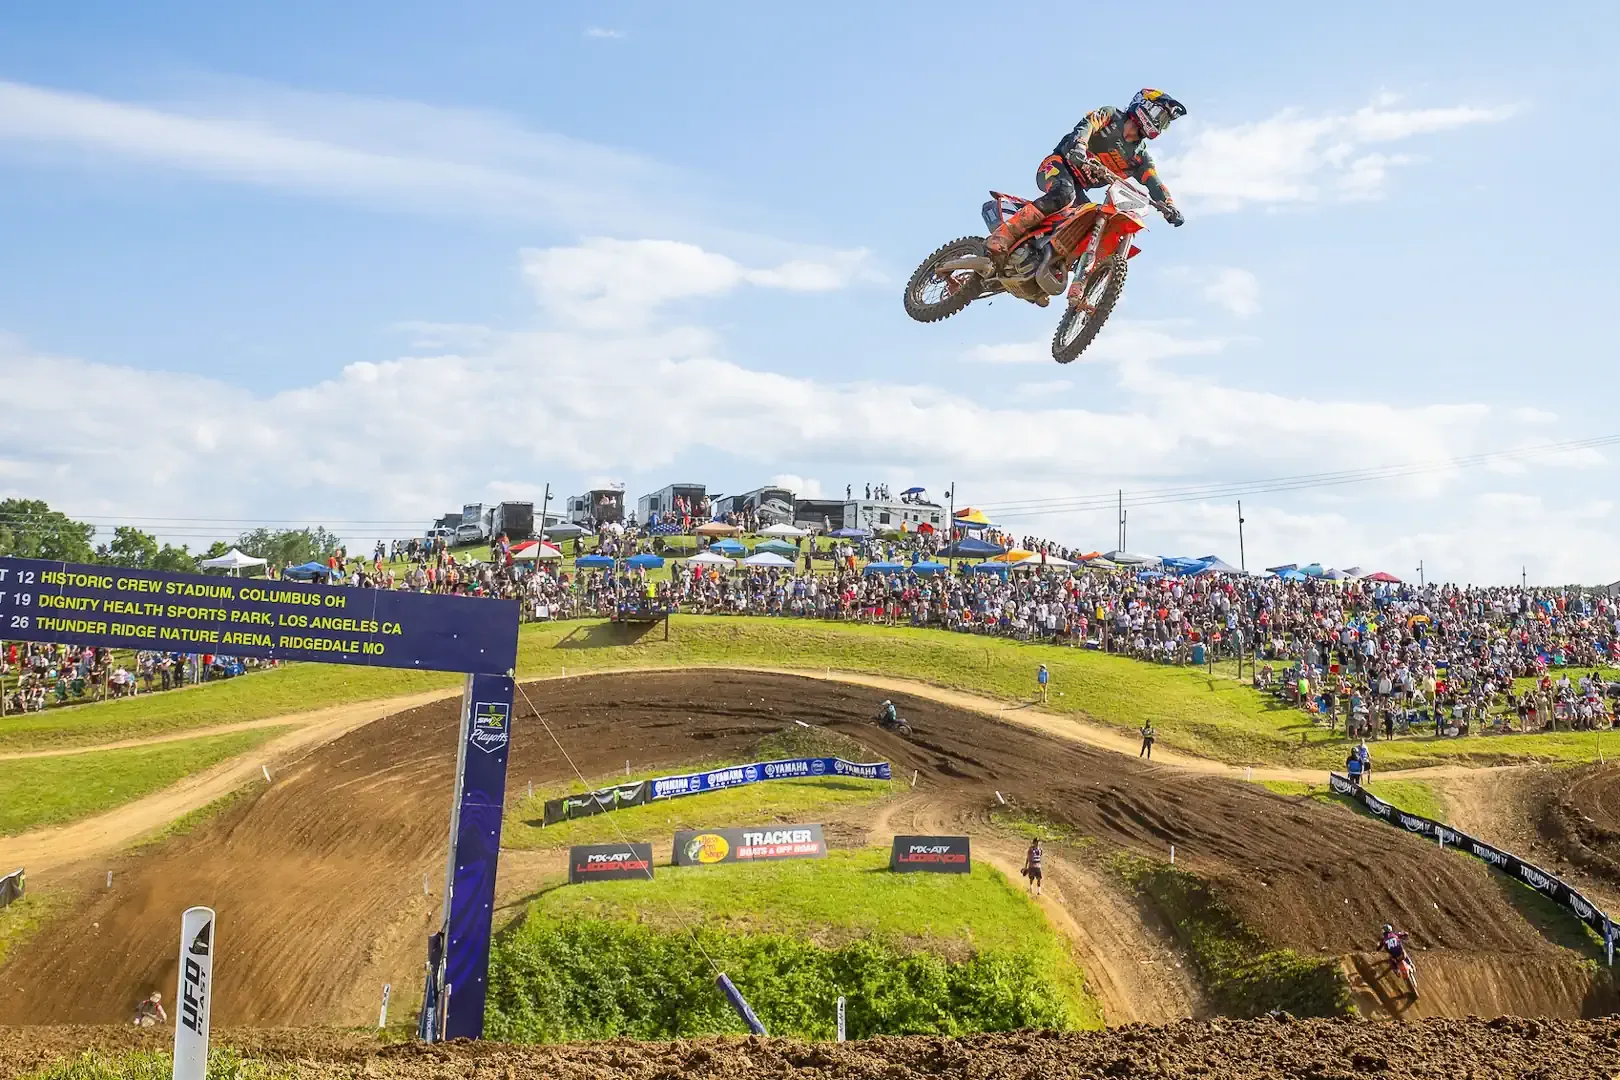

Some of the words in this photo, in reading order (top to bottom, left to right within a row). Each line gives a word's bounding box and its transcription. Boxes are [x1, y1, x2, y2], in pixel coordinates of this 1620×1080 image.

[17, 570, 35, 584] 12
[40, 571, 113, 589] HISTORIC
[117, 578, 162, 593] CREW
[165, 581, 236, 601] STADIUM,
[239, 588, 321, 607] COLUMBUS
[324, 595, 346, 608] OH
[13, 592, 31, 606] 19
[38, 595, 101, 611] DIGNITY
[103, 600, 164, 617] HEALTH
[167, 605, 227, 622] SPORTS
[231, 611, 275, 627] PARK,
[279, 613, 308, 629] LOS
[311, 617, 379, 633] ANGELES
[381, 622, 402, 635] CA
[10, 615, 29, 629] 26
[35, 616, 107, 635] THUNDER
[111, 623, 156, 638] RIDGE
[160, 627, 219, 643] NATURE
[222, 633, 276, 649] ARENA,
[279, 636, 360, 653] RIDGEDALE
[362, 642, 385, 655] MO
[477, 715, 503, 727] SMX
[470, 728, 508, 744] Playoffs
[775, 761, 808, 774] YAMAHA
[843, 764, 877, 776] YAMAHA
[715, 769, 744, 783] YAMAHA
[661, 778, 688, 791] YAMAHA
[742, 829, 812, 846] TRACKER
[587, 852, 632, 863] MX-ATV
[739, 846, 768, 857] BOATS
[909, 845, 950, 854] MX-ATV
[1472, 843, 1500, 864] TRIUMPH
[1520, 864, 1550, 890] TRIUMPH
[182, 956, 200, 1031] UFO
[197, 966, 206, 1036] PLAST
